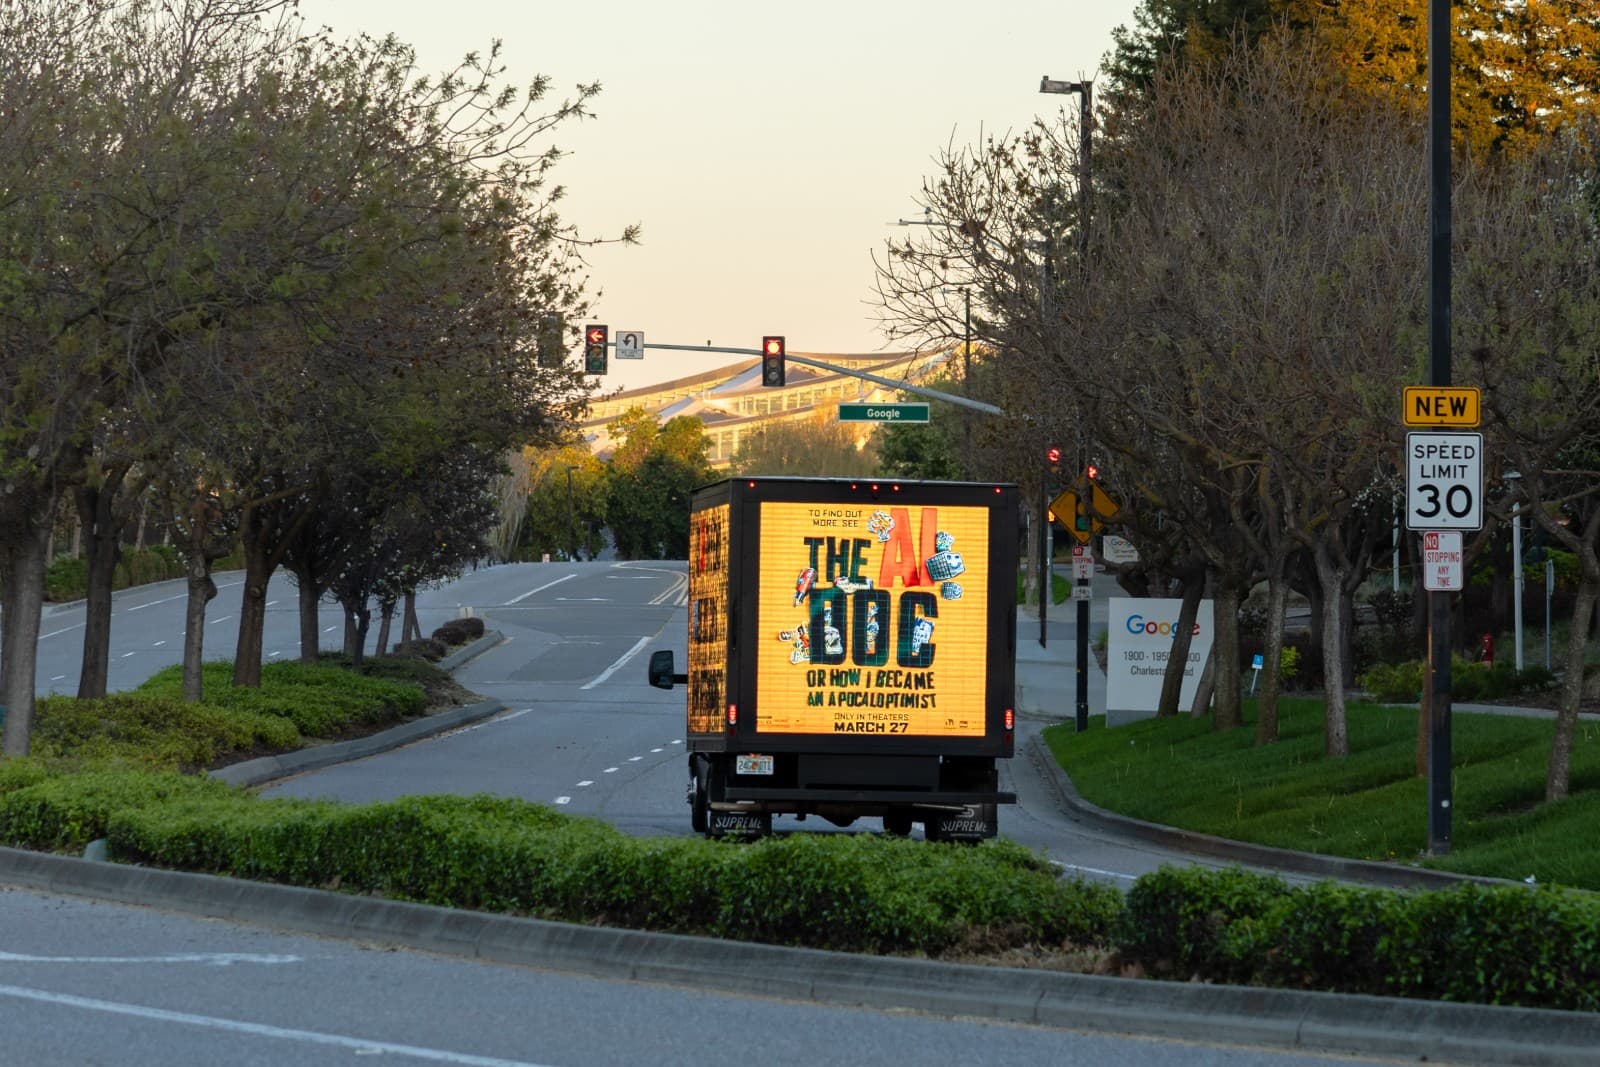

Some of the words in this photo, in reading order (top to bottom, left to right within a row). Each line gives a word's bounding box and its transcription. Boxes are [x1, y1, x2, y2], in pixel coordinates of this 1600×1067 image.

[1415, 396, 1468, 417] NEW
[866, 408, 901, 420] Google
[1414, 444, 1475, 460] SPEED
[1420, 464, 1469, 479] LIMIT
[1415, 483, 1473, 518] 30
[808, 509, 821, 518] TO
[823, 510, 843, 518] FIND
[845, 510, 863, 518] OUT
[813, 519, 837, 527] MORE
[842, 519, 859, 528] SEE
[804, 536, 872, 585] THE
[879, 507, 938, 588] AI
[1426, 535, 1438, 548] NO
[1427, 551, 1460, 563] STOPPING
[1437, 565, 1450, 575] ANY
[809, 587, 939, 668] DOC
[1126, 614, 1201, 640] Gooe
[1123, 651, 1145, 661] 1900
[1130, 665, 1166, 676] Charlest
[807, 669, 826, 688] OR
[830, 668, 862, 688] HOW
[865, 671, 872, 689] I
[875, 669, 935, 690] BECAME
[807, 691, 824, 707] AN
[828, 691, 937, 709] APOCALOPTIMIST
[834, 712, 855, 720] ONLY
[868, 713, 910, 721] THEATERS
[833, 722, 885, 733] MARCH
[889, 722, 909, 733] 27
